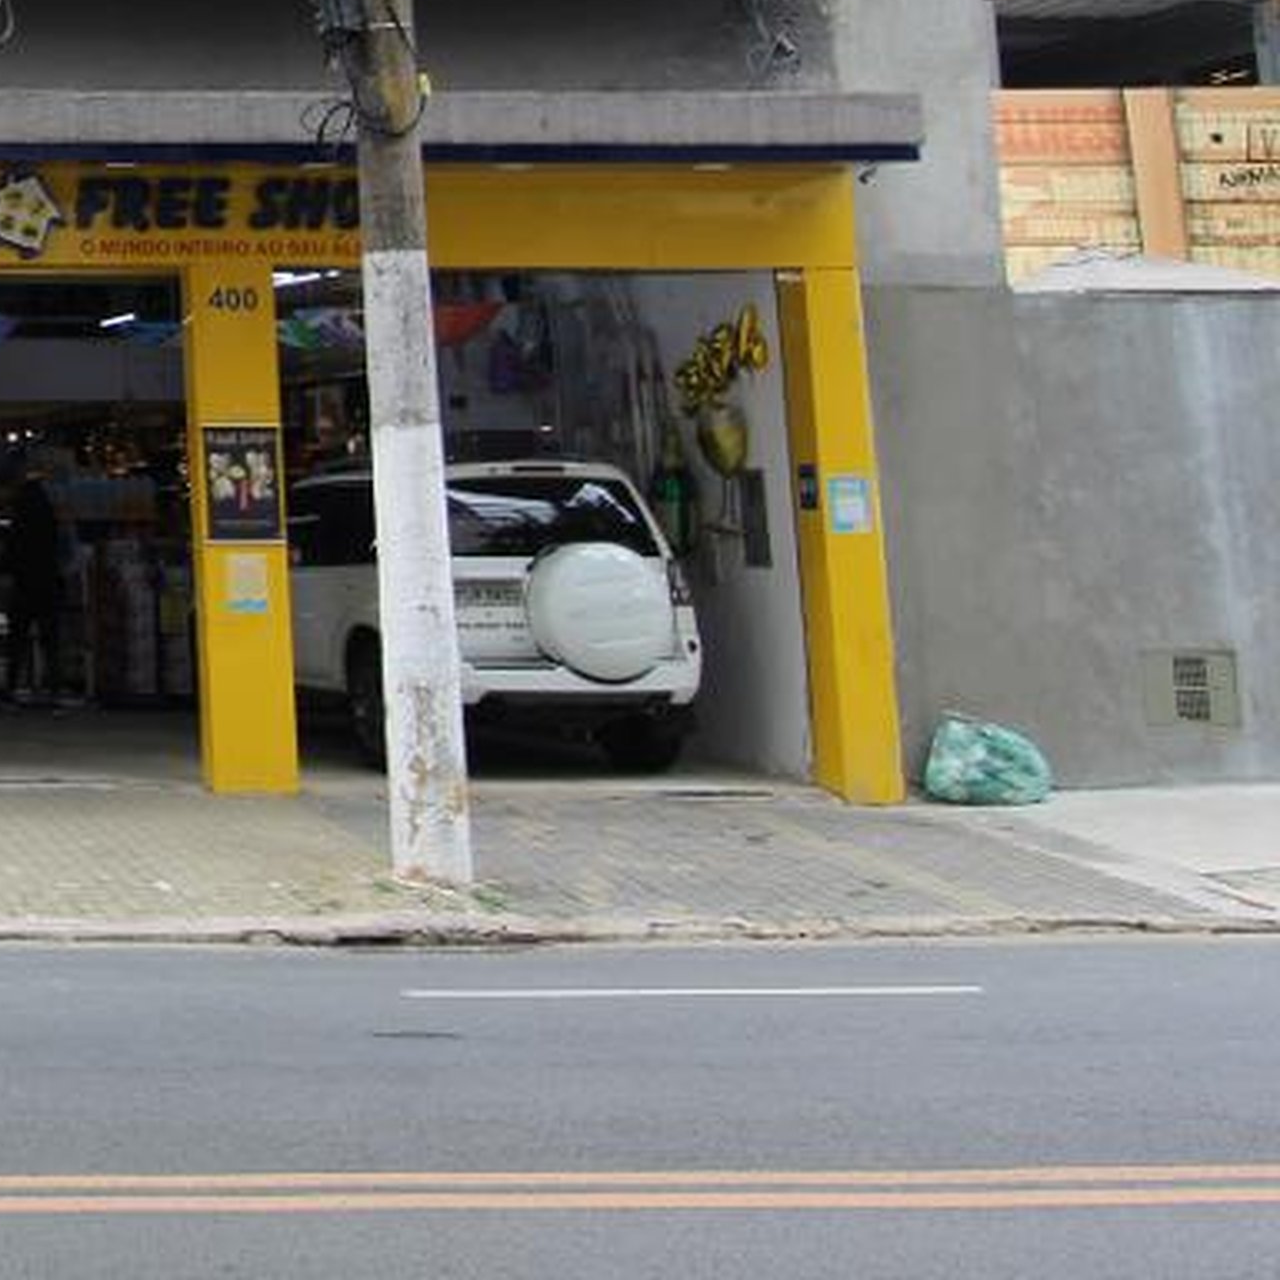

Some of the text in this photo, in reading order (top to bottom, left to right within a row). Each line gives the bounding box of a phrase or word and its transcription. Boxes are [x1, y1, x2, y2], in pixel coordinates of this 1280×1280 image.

[77, 178, 360, 231] FREE SHO
[98, 239, 171, 257] MUNDO
[175, 239, 250, 258] INTEIRO
[209, 287, 258, 312] 400
